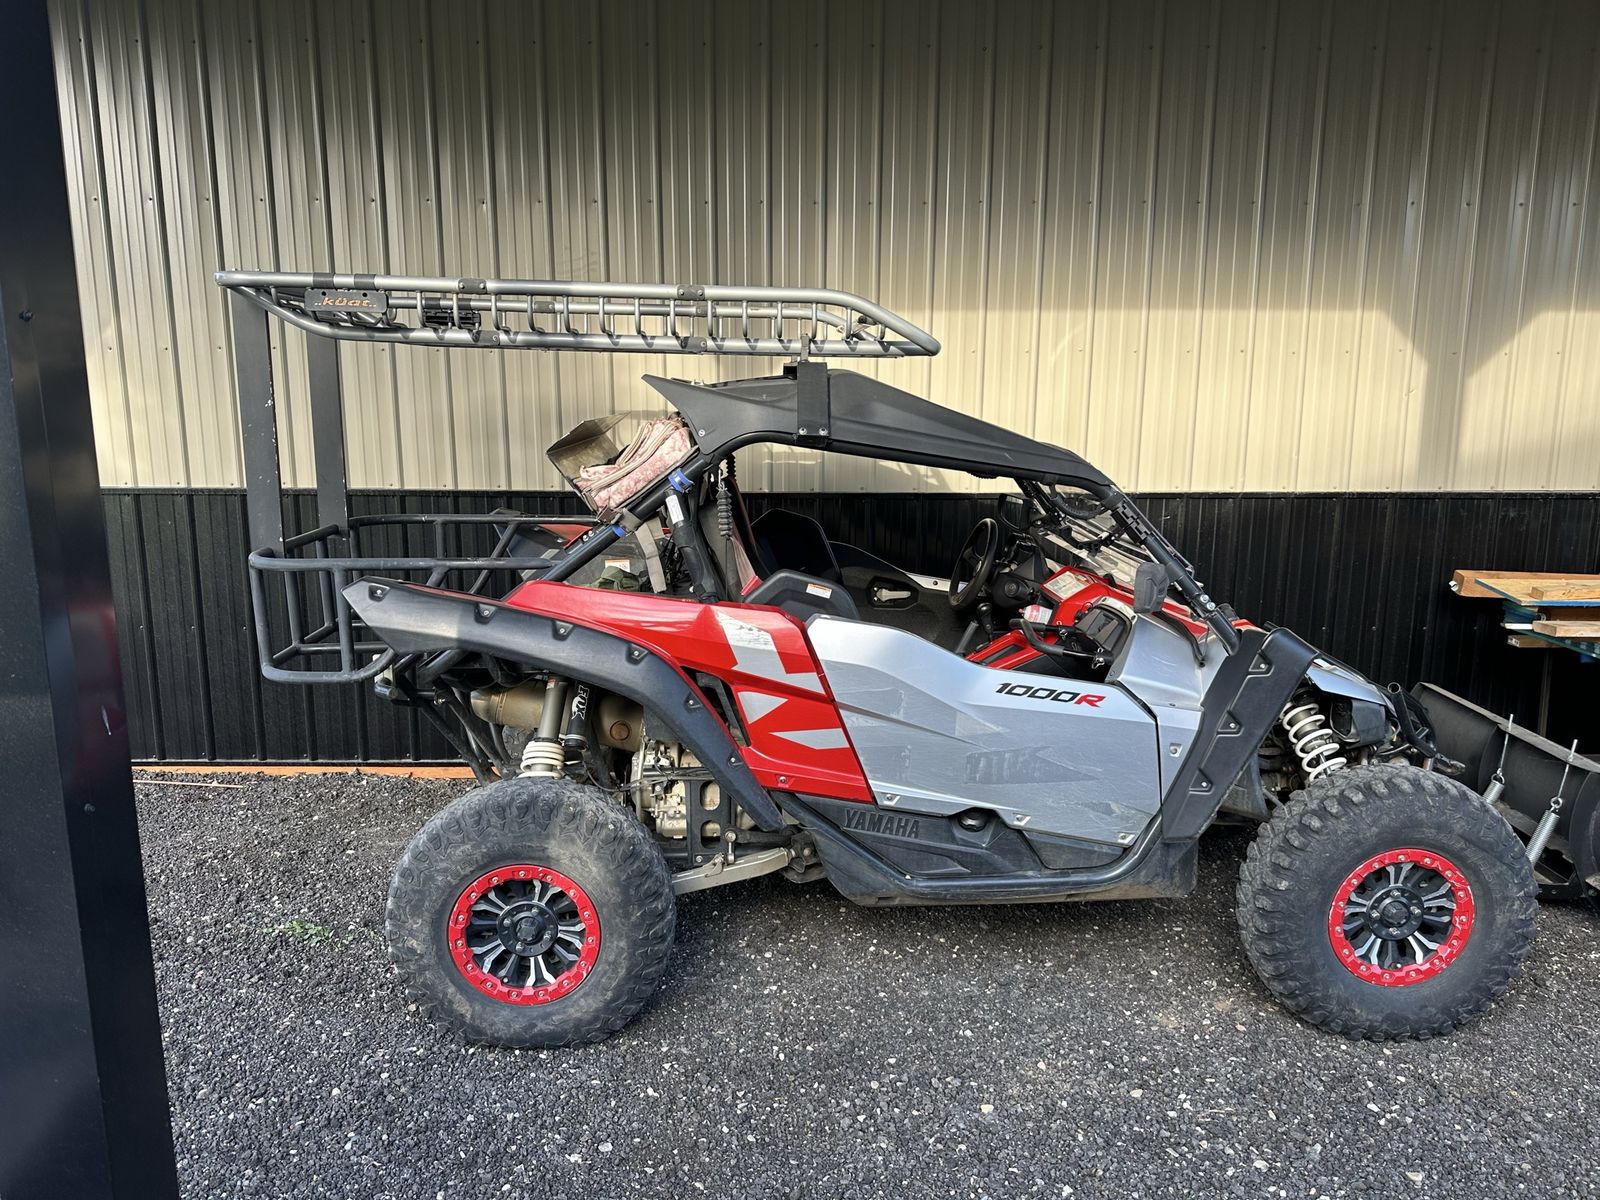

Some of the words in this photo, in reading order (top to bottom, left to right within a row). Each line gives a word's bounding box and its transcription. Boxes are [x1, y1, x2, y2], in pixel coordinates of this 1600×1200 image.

[571, 685, 589, 720] FOX
[995, 683, 1105, 708] 1000R
[845, 808, 920, 838] YAMAHA
